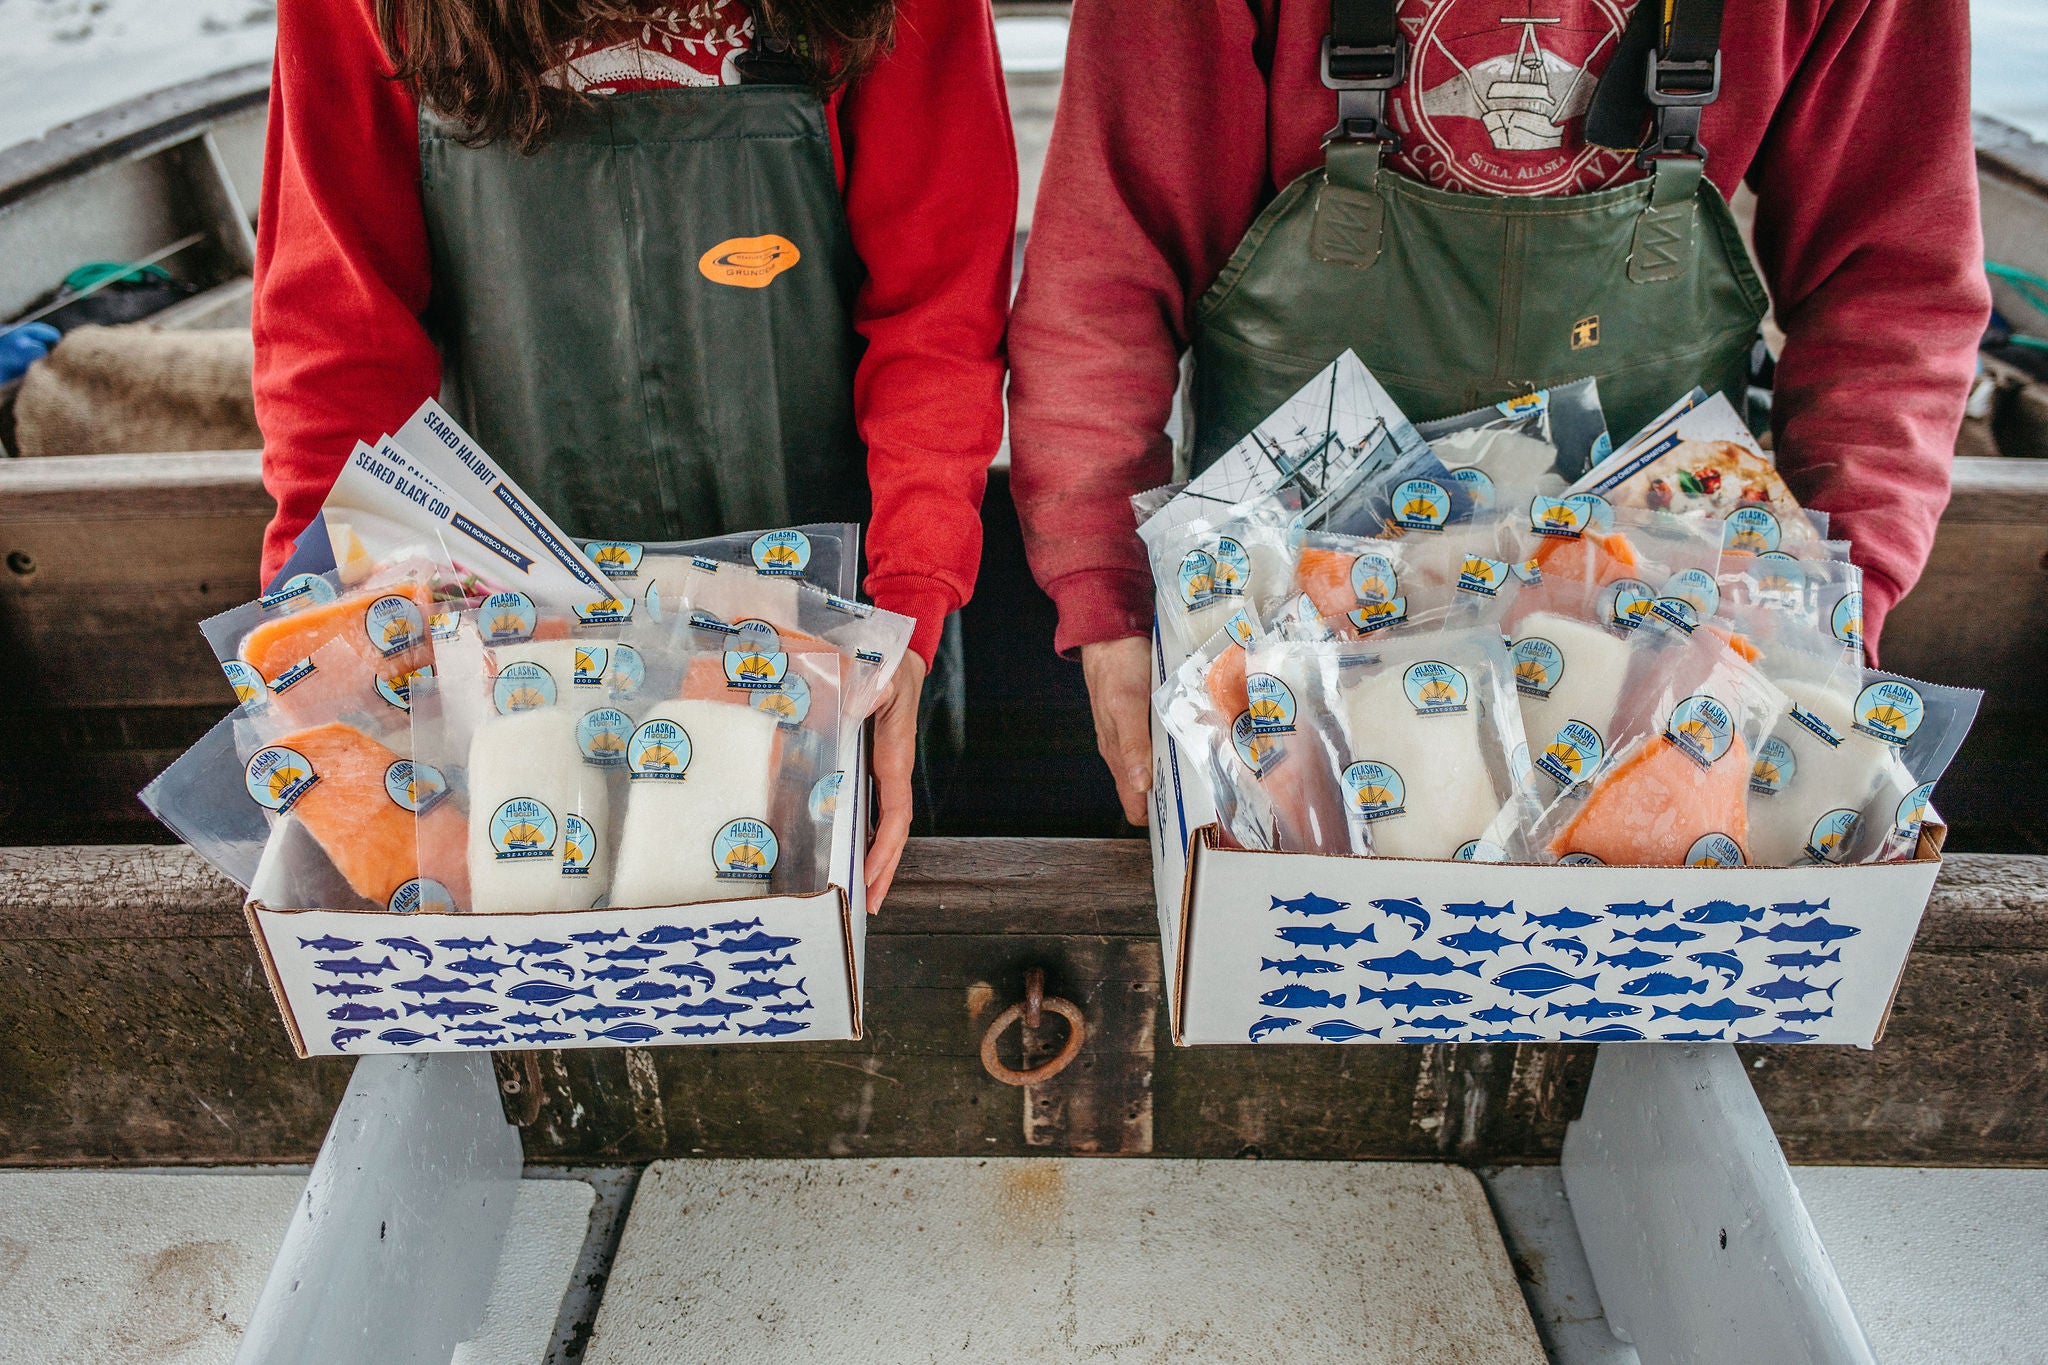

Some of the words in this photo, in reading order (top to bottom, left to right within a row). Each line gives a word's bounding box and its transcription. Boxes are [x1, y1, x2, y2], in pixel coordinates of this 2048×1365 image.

[1518, 155, 1567, 180] ALASKA
[424, 411, 460, 449] SEARED
[455, 444, 497, 486] HALIBUT
[1640, 442, 1671, 463] TOMATOES
[356, 452, 396, 484] SEARED
[394, 476, 430, 507] BLACK
[428, 498, 451, 520] COD
[1407, 482, 1437, 494] ALASKA
[1737, 510, 1768, 526] ALASKA
[456, 518, 472, 533] WITH
[472, 528, 501, 550] ROMESCO
[500, 546, 521, 563] SAUCE
[499, 487, 514, 505] WITH
[537, 528, 551, 544] WILD
[550, 542, 586, 579] MUSHROOMS
[768, 531, 798, 542] ALASKA
[1219, 541, 1237, 556] ASKA
[374, 598, 403, 619] ALASKA
[490, 592, 521, 608] ALASKA
[1367, 618, 1399, 632] SEAFOOD
[1653, 607, 1685, 627] SEAFOOD
[1521, 641, 1553, 659] ALASKA
[1414, 664, 1447, 677] ALASKA
[1248, 678, 1277, 694] ALASKA
[1878, 684, 1914, 706] ALASKA
[1886, 693, 1906, 703] GOLD
[589, 710, 622, 727] ALASKA
[1696, 700, 1728, 729] ALASKA
[1702, 710, 1719, 725] GOLD
[644, 723, 676, 739] ALASKA
[1236, 714, 1253, 739] ALAS
[1799, 717, 1831, 741] SEAFOOD
[1563, 724, 1596, 750] ALASKA
[1569, 733, 1587, 746] GOLD
[1766, 741, 1786, 759] ASKA
[251, 751, 281, 780] ALASKA
[1351, 764, 1384, 781] ALASKA
[1538, 759, 1570, 784] SEAFOOD
[285, 780, 312, 807] SEAFOOD
[506, 801, 540, 818] ALASKA
[731, 822, 763, 839] ALASKA
[1712, 837, 1739, 865] ALASKA
